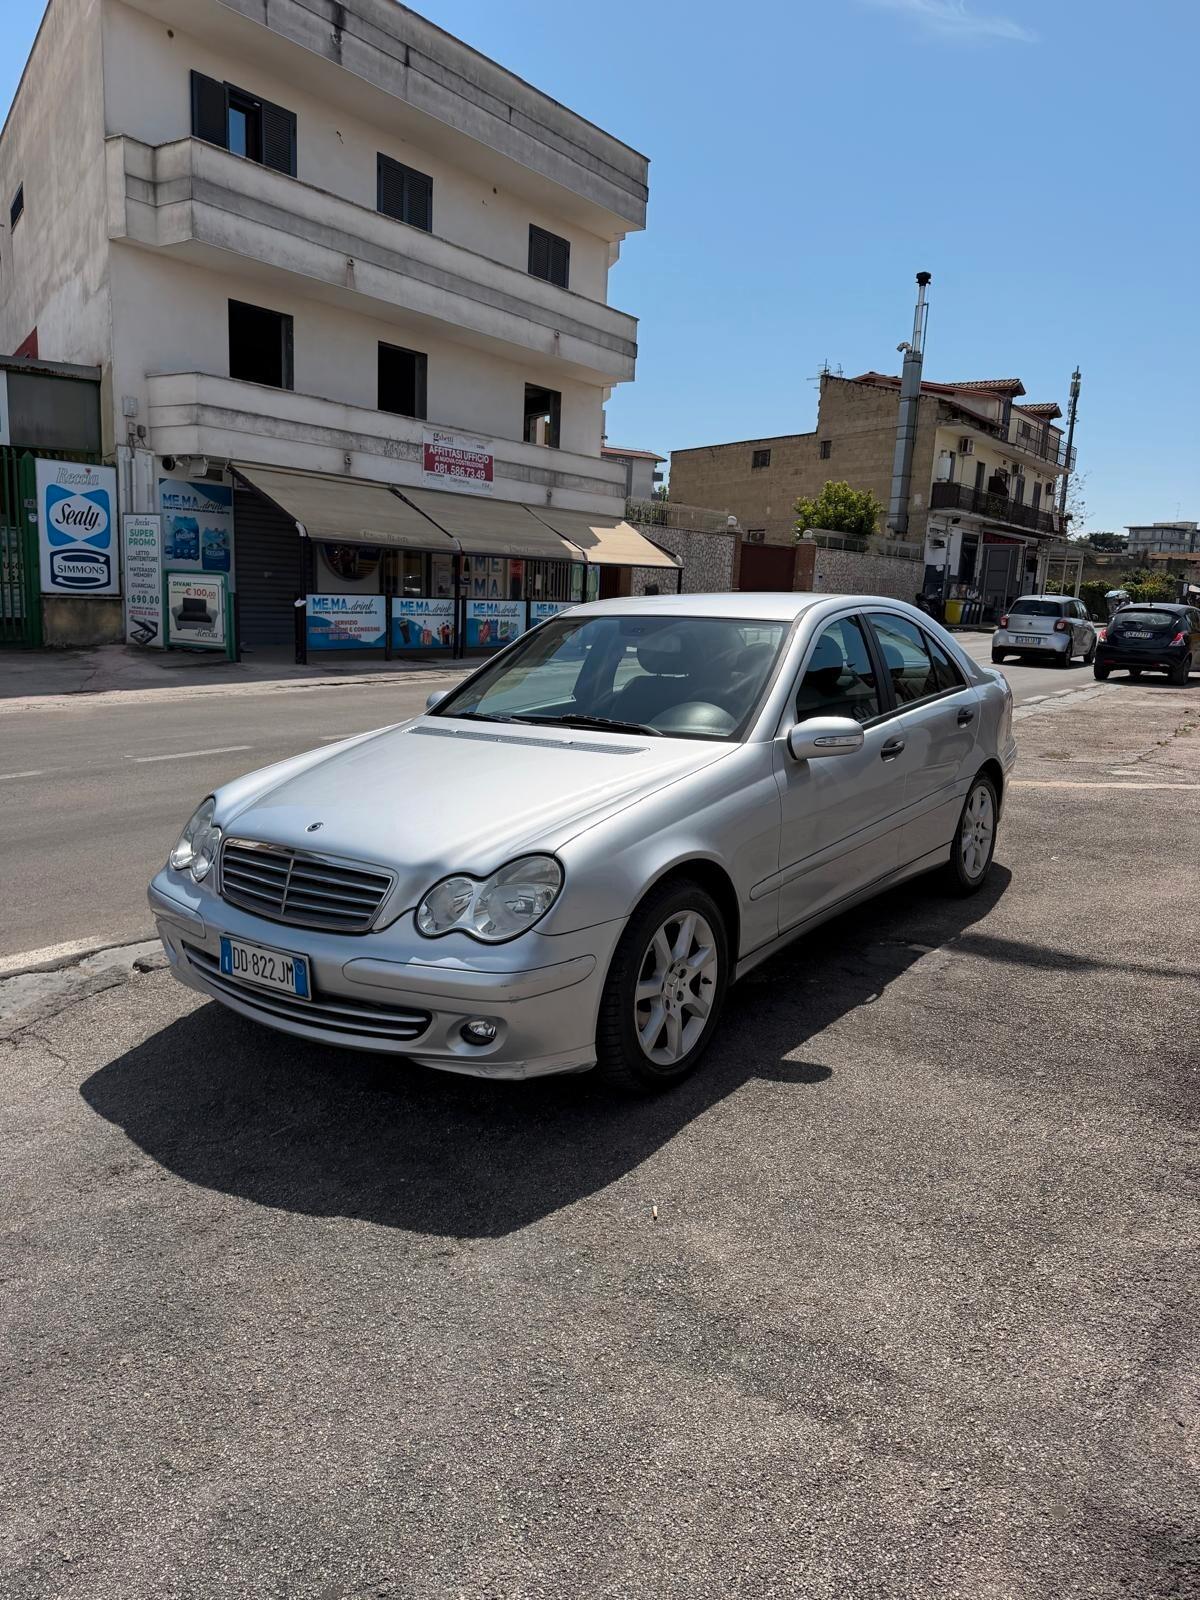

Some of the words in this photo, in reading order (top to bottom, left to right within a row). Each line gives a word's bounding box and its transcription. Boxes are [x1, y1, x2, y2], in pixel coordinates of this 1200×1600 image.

[429, 445, 462, 459] AFFITTASI
[464, 452, 489, 464] UFFICIO
[55, 503, 100, 531] Sealy
[129, 529, 154, 537] SUPER
[128, 538, 156, 546] PROMO
[58, 564, 105, 575] SIMMONS
